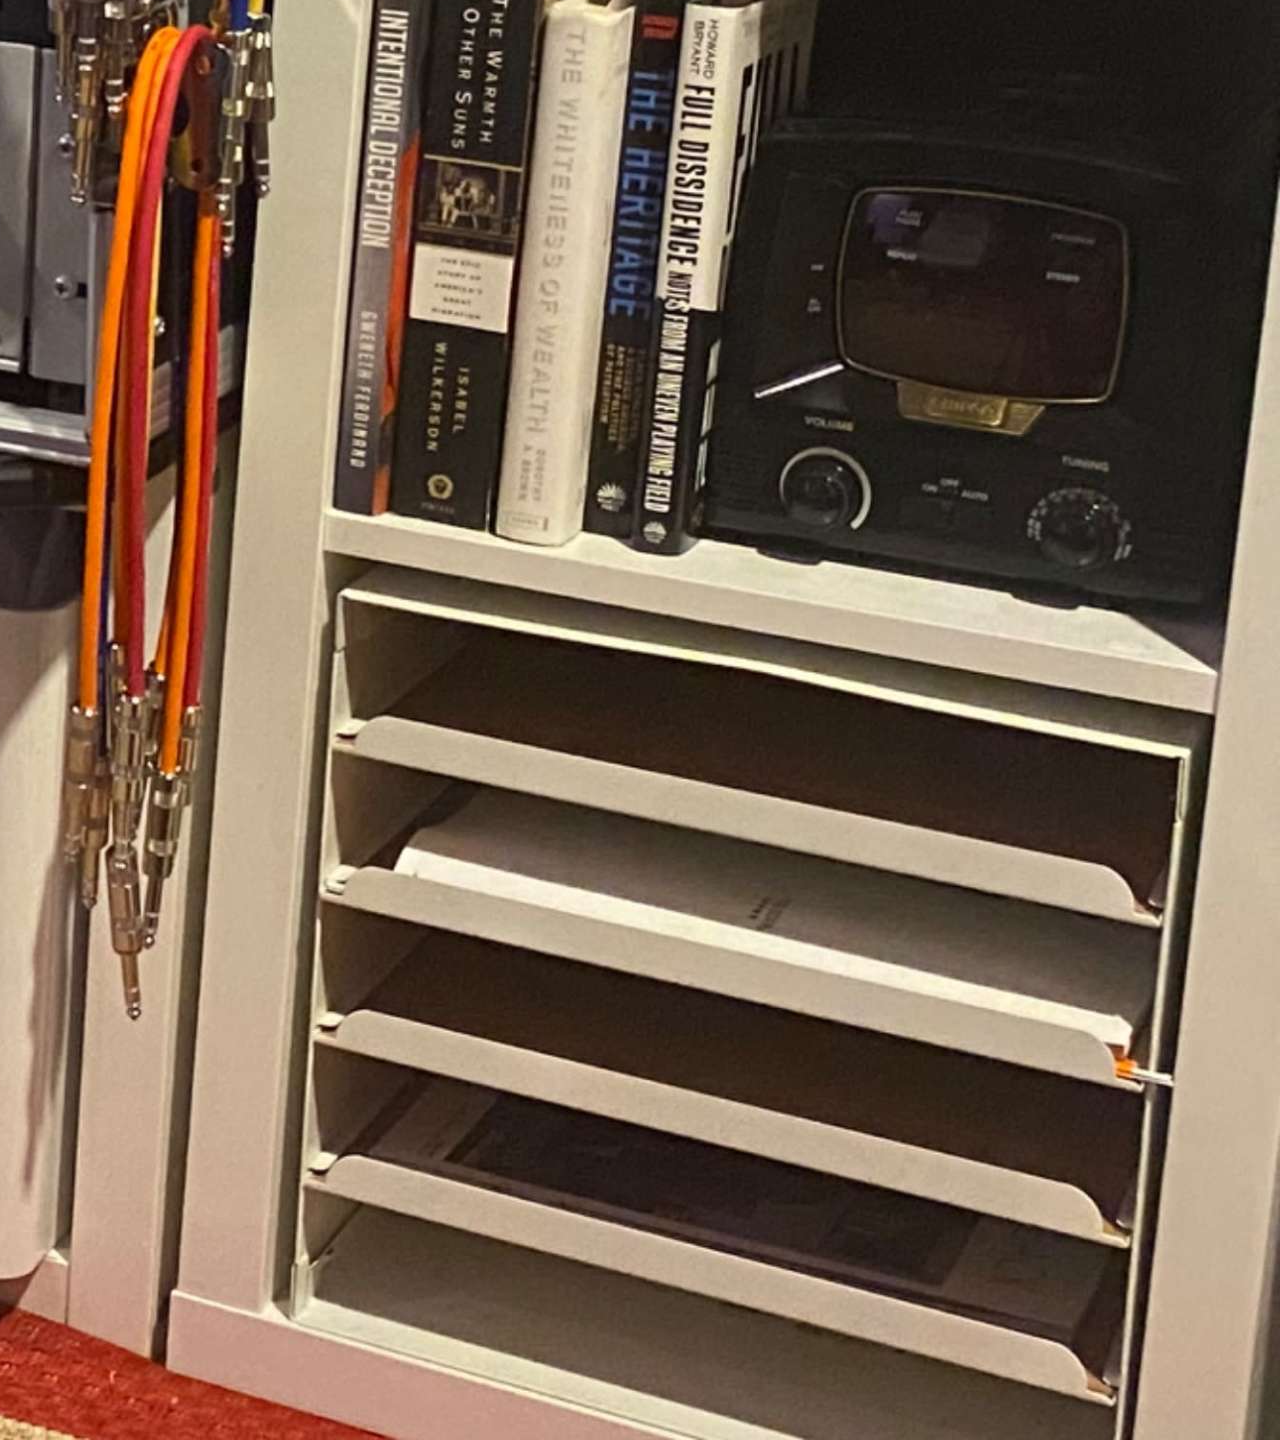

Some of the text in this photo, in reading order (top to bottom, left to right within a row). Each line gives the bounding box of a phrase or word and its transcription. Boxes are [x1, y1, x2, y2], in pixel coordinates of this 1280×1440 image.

[456, 7, 481, 81] OTHER
[560, 28, 587, 85] THE
[692, 20, 706, 78] BRYANT
[702, 18, 720, 80] HOWARD
[361, 8, 410, 249] INTENTIONAL DECEPTION
[450, 90, 473, 150] SUNS
[478, 50, 504, 144] WARMTH
[627, 70, 660, 133] THE
[608, 145, 654, 317] HERITAGE
[540, 278, 561, 316] OF
[642, 83, 715, 515] FULL DISSIDENCE NOTES FROM AN UNEVEN PLAYING FIELD
[426, 341, 449, 453] WILKERSON
[451, 366, 471, 434] ISABEL
[524, 324, 559, 435] WEALTH
[804, 415, 855, 432] VOLUME
[1061, 454, 1110, 472] TUNING
[960, 489, 989, 503] AUTO
